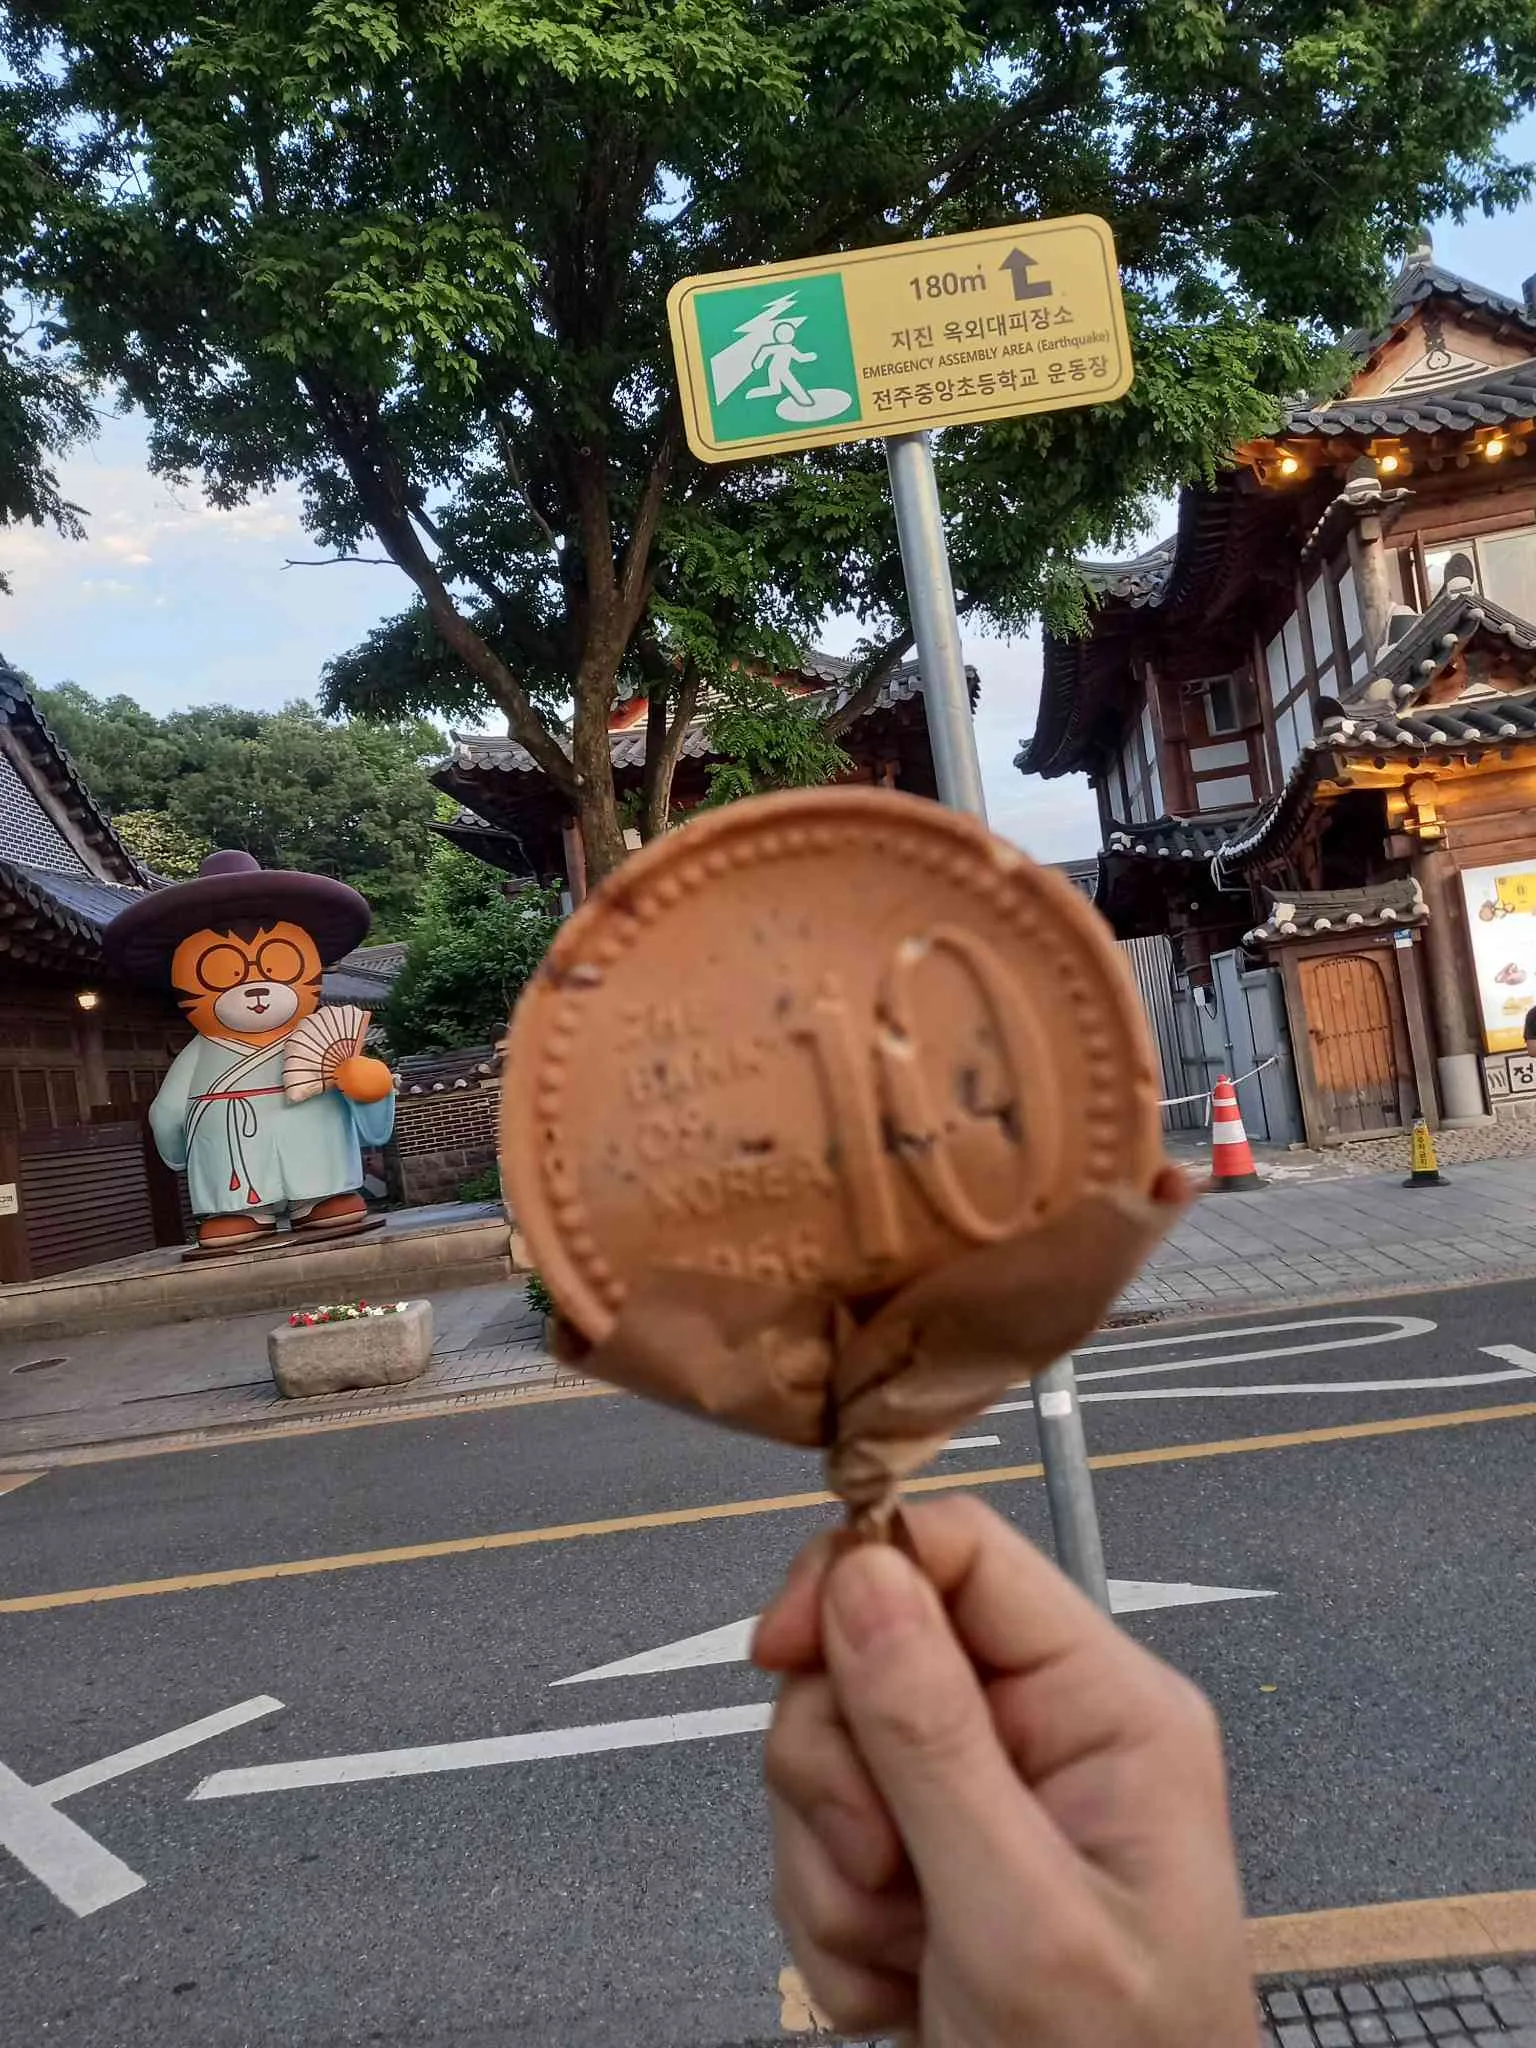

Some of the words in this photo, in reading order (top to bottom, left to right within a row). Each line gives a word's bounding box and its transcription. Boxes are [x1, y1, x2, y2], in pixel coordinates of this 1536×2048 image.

[862, 357, 934, 379] EMERGENCY
[938, 348, 998, 368] ASSEMBLY
[1002, 343, 1034, 357] AREA
[1037, 329, 1110, 353] (Earthquake)
[891, 325, 934, 351] 지진
[943, 305, 1074, 343] 옥외대피장소
[872, 367, 1039, 412] 전주중앙초등학교
[1047, 354, 1109, 384] 운동장
[790, 924, 1063, 1262] 10
